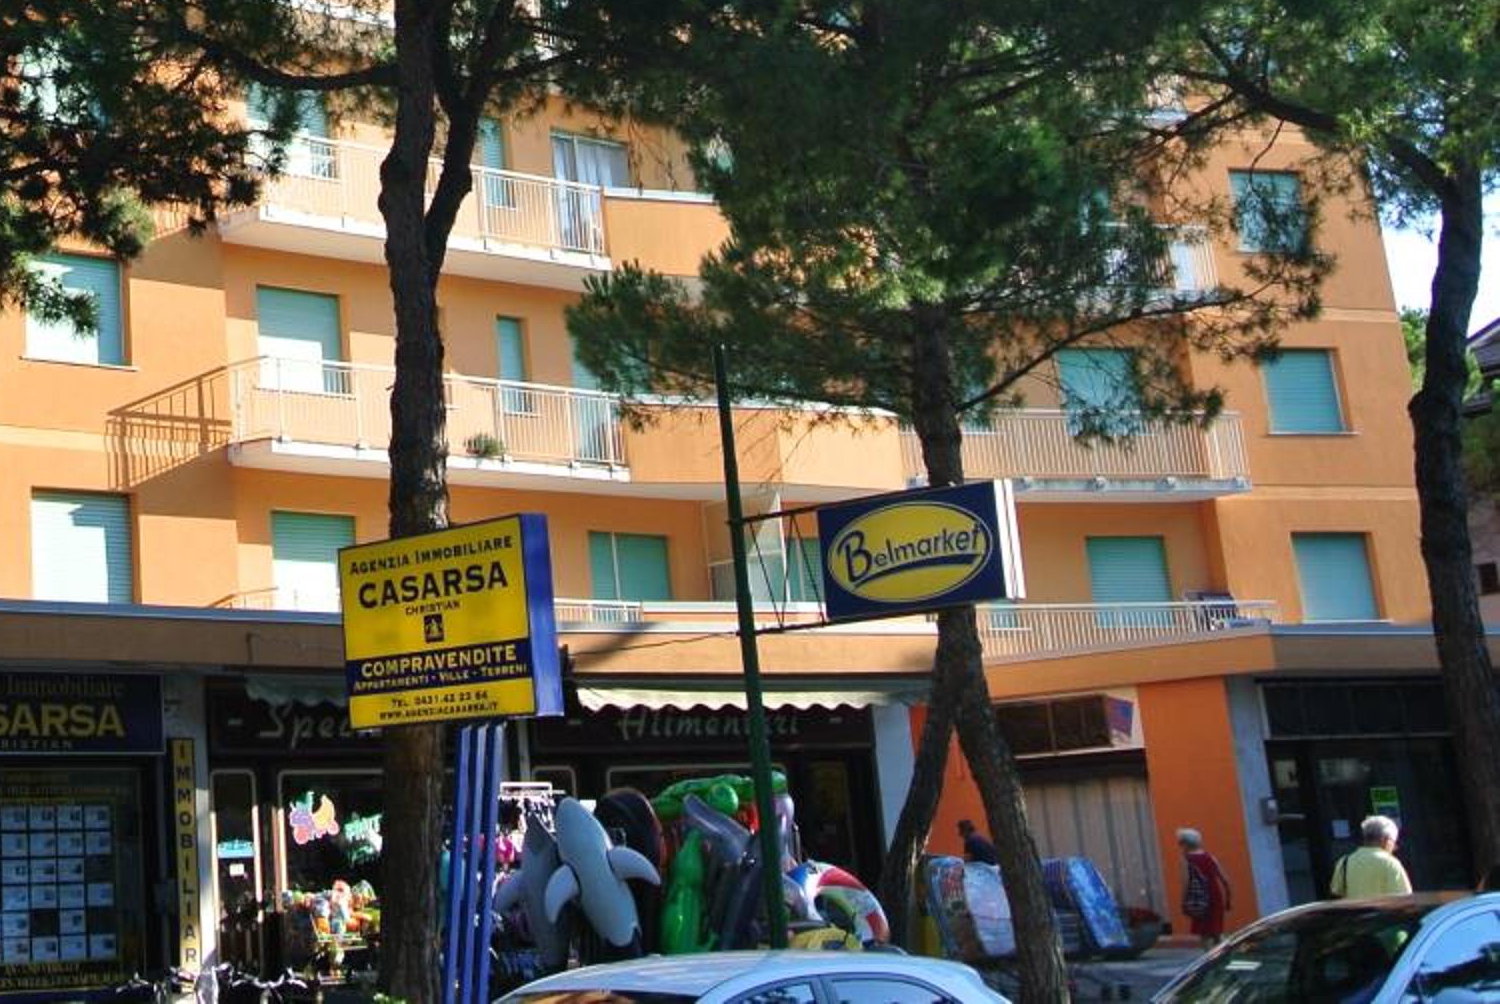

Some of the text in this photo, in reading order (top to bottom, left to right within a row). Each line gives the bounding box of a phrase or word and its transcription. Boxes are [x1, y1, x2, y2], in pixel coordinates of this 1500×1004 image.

[349, 535, 513, 576] AGENZIA IMMOBILIARE
[836, 523, 982, 583] Belmarket
[358, 560, 509, 610] CASARSA
[405, 599, 461, 616] CHRISTIAN
[360, 644, 517, 679] COMPRAVENDITE
[176, 743, 198, 976] IMMOBILIAR
